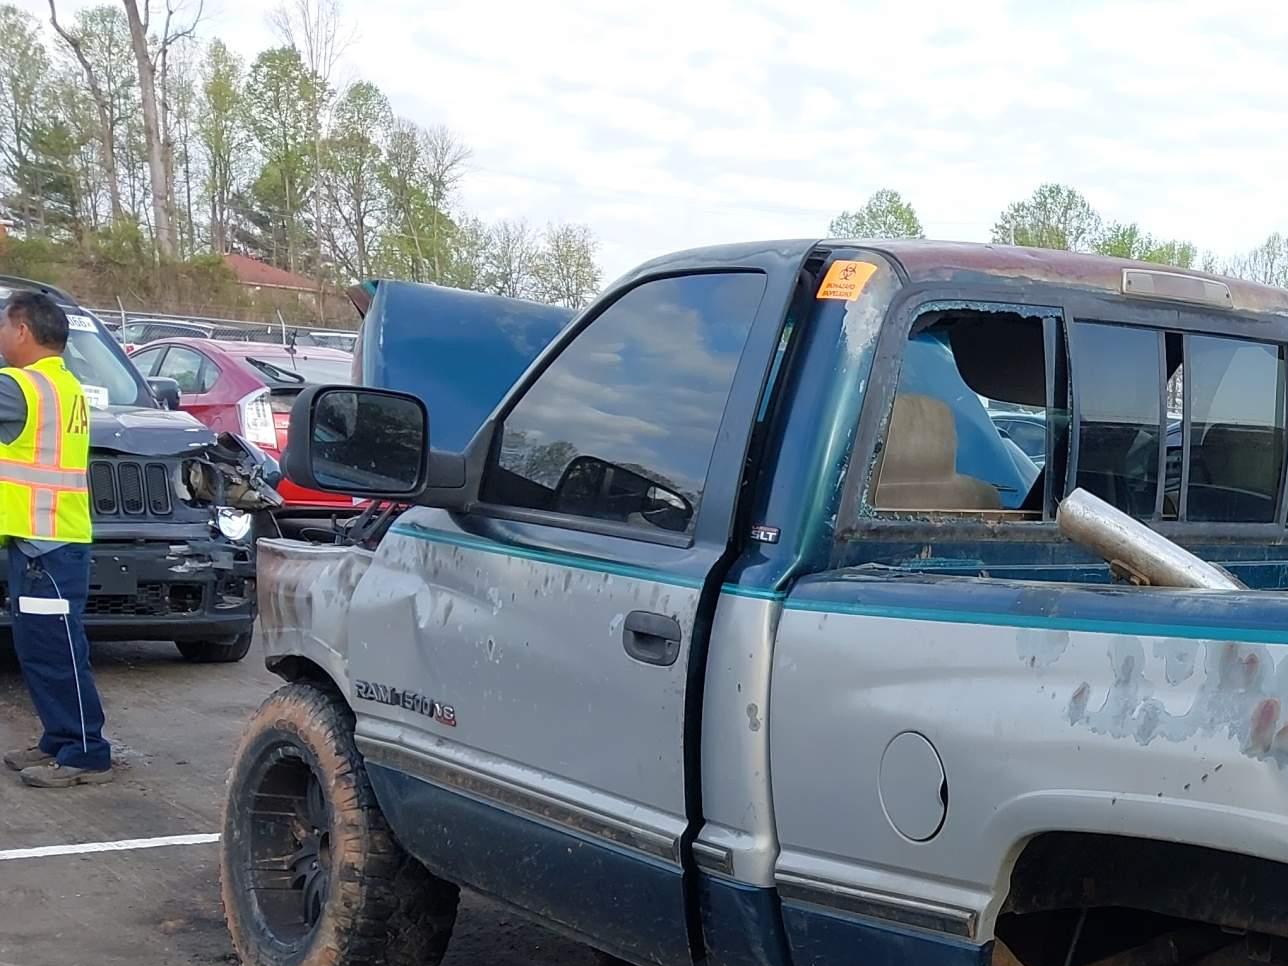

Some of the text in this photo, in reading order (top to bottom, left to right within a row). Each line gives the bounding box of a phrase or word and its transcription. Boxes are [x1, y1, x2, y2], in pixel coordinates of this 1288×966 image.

[751, 529, 777, 542] SLT
[355, 679, 434, 718] RAM 1500
